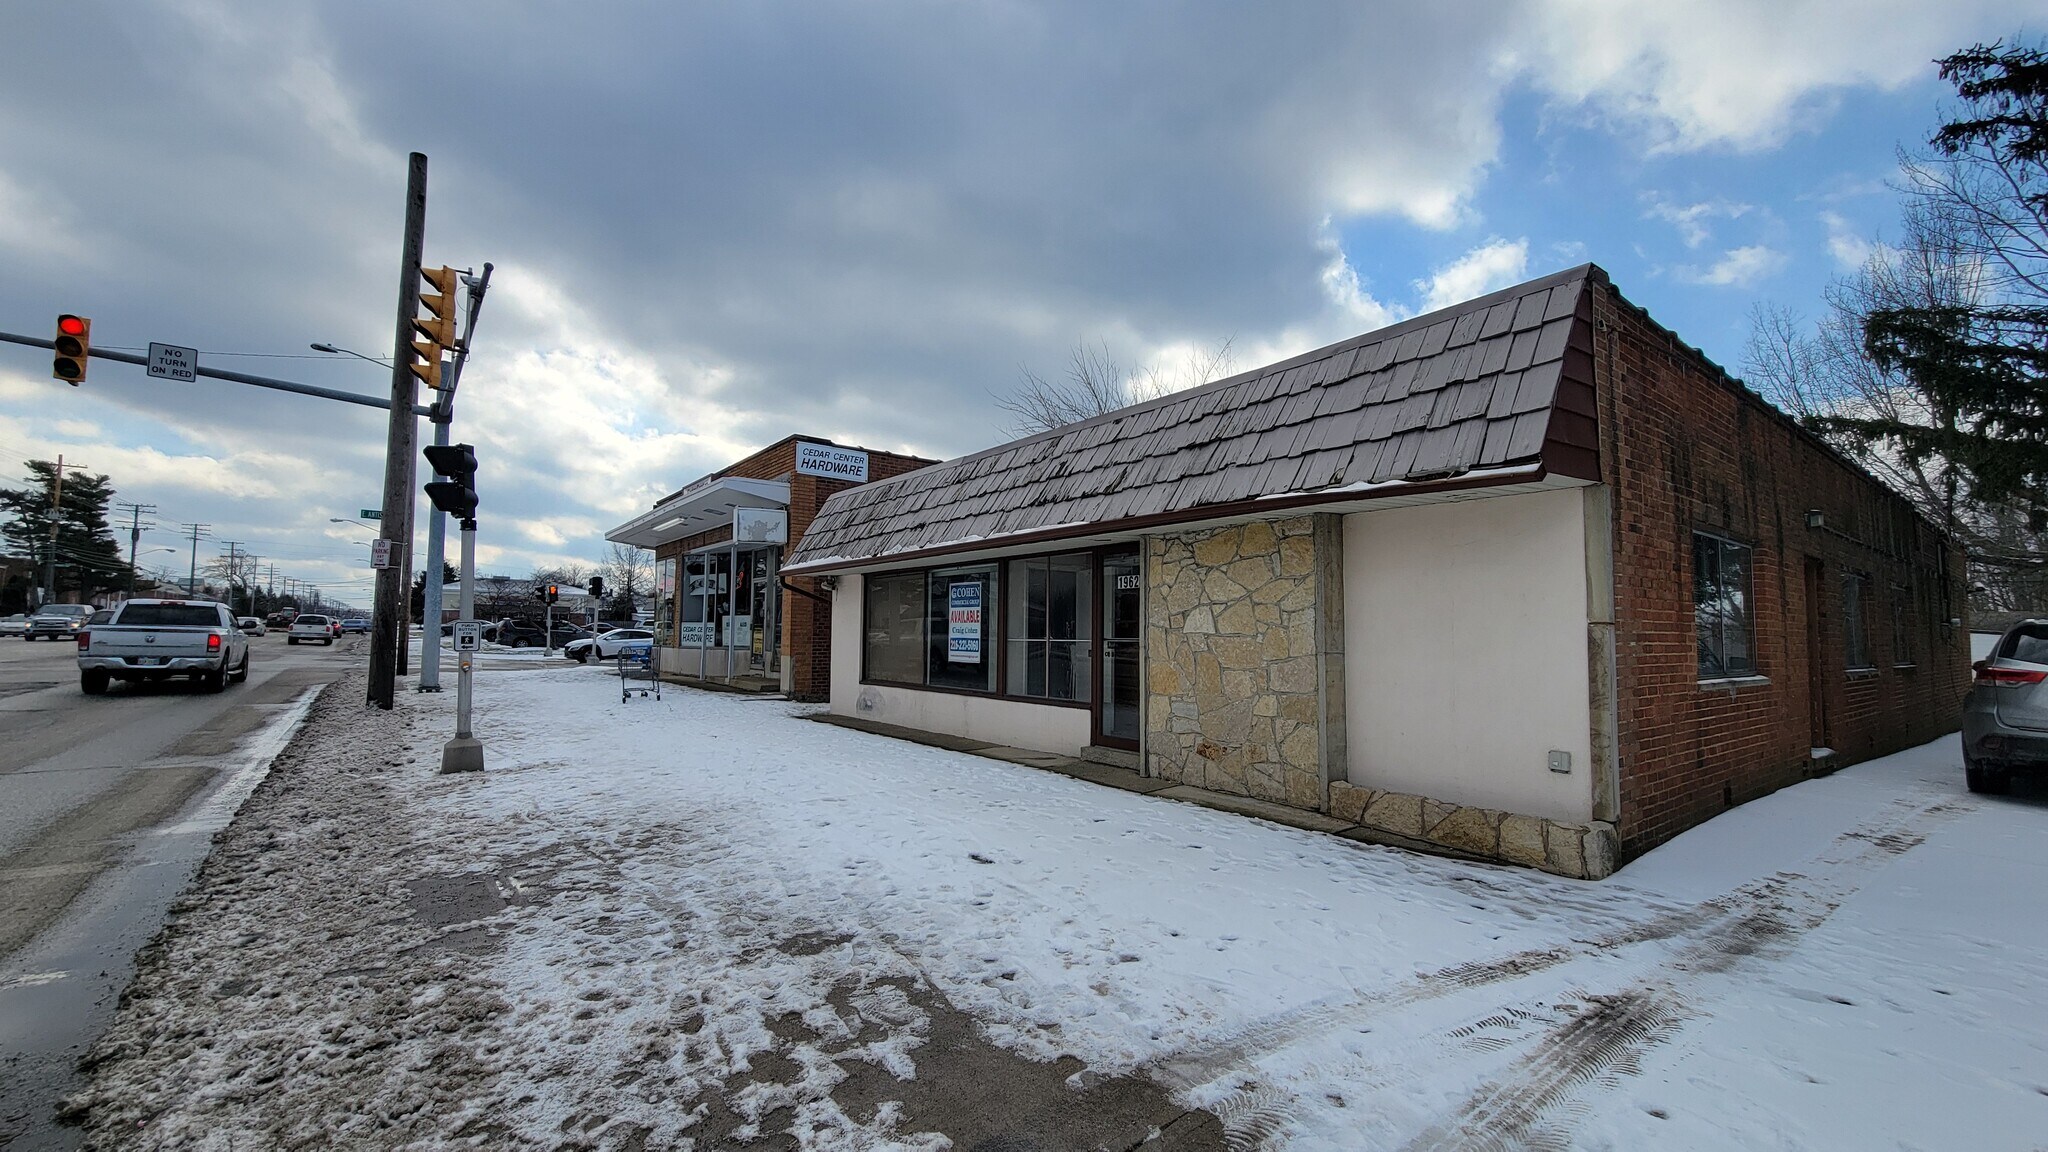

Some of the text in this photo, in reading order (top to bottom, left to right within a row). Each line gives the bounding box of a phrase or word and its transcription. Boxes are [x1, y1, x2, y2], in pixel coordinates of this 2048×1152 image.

[165, 348, 182, 358] NO
[159, 357, 187, 368] TURN
[152, 366, 192, 378] ON RED
[802, 448, 865, 464] CEDAR CENTER
[800, 458, 864, 476] HARDWARE
[1118, 576, 1139, 588] 1962
[950, 610, 980, 623] AVAILABLE
[682, 634, 714, 642] HARDWRE
